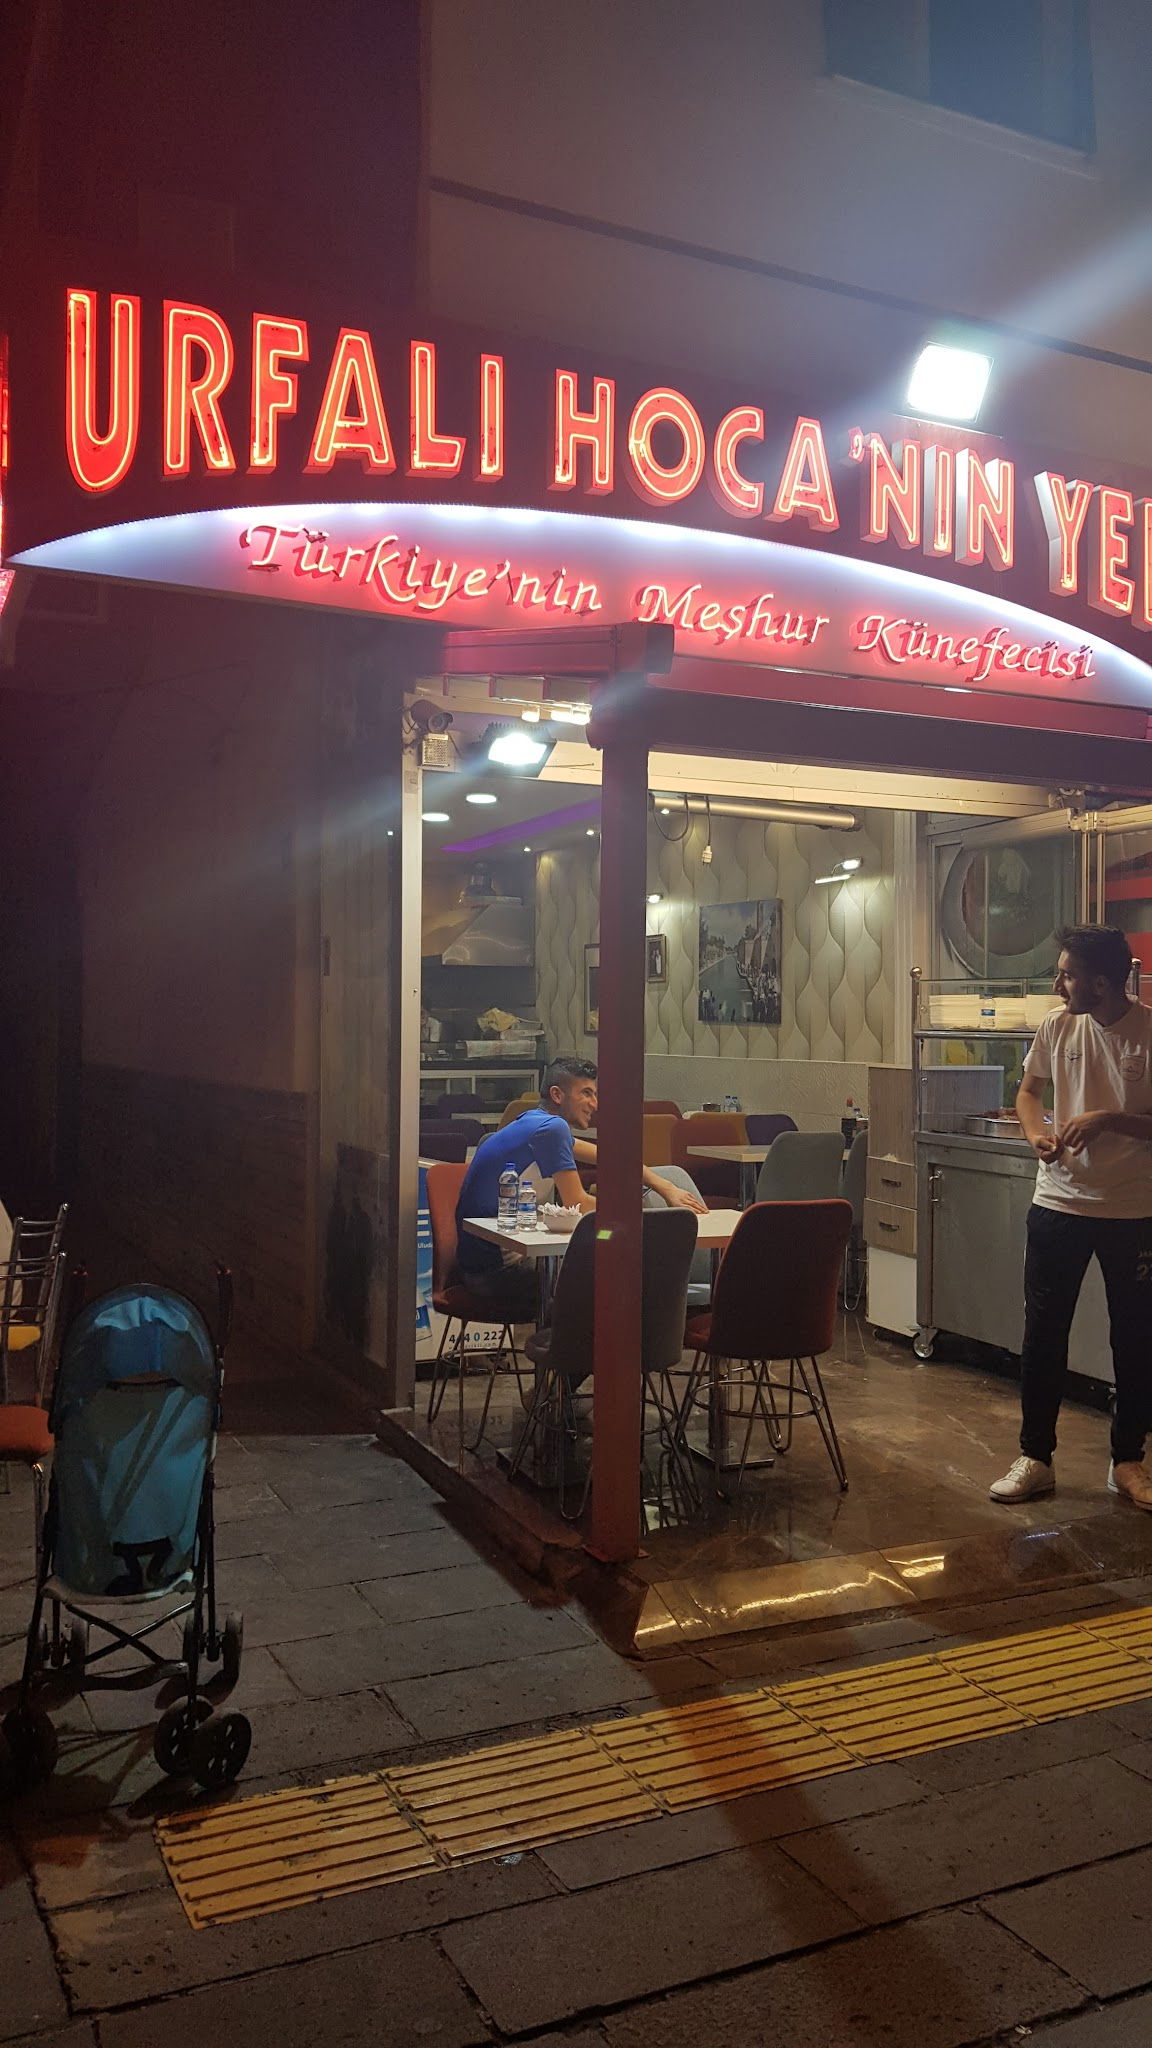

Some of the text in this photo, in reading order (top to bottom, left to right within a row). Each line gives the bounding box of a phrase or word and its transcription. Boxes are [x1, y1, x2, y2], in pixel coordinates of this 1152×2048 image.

[66, 287, 1152, 626] URFALI HOCA'NIN YE
[243, 523, 1097, 682] Türkiye'nin Meşhur Künefecisi
[448, 1333, 470, 1344] 44
